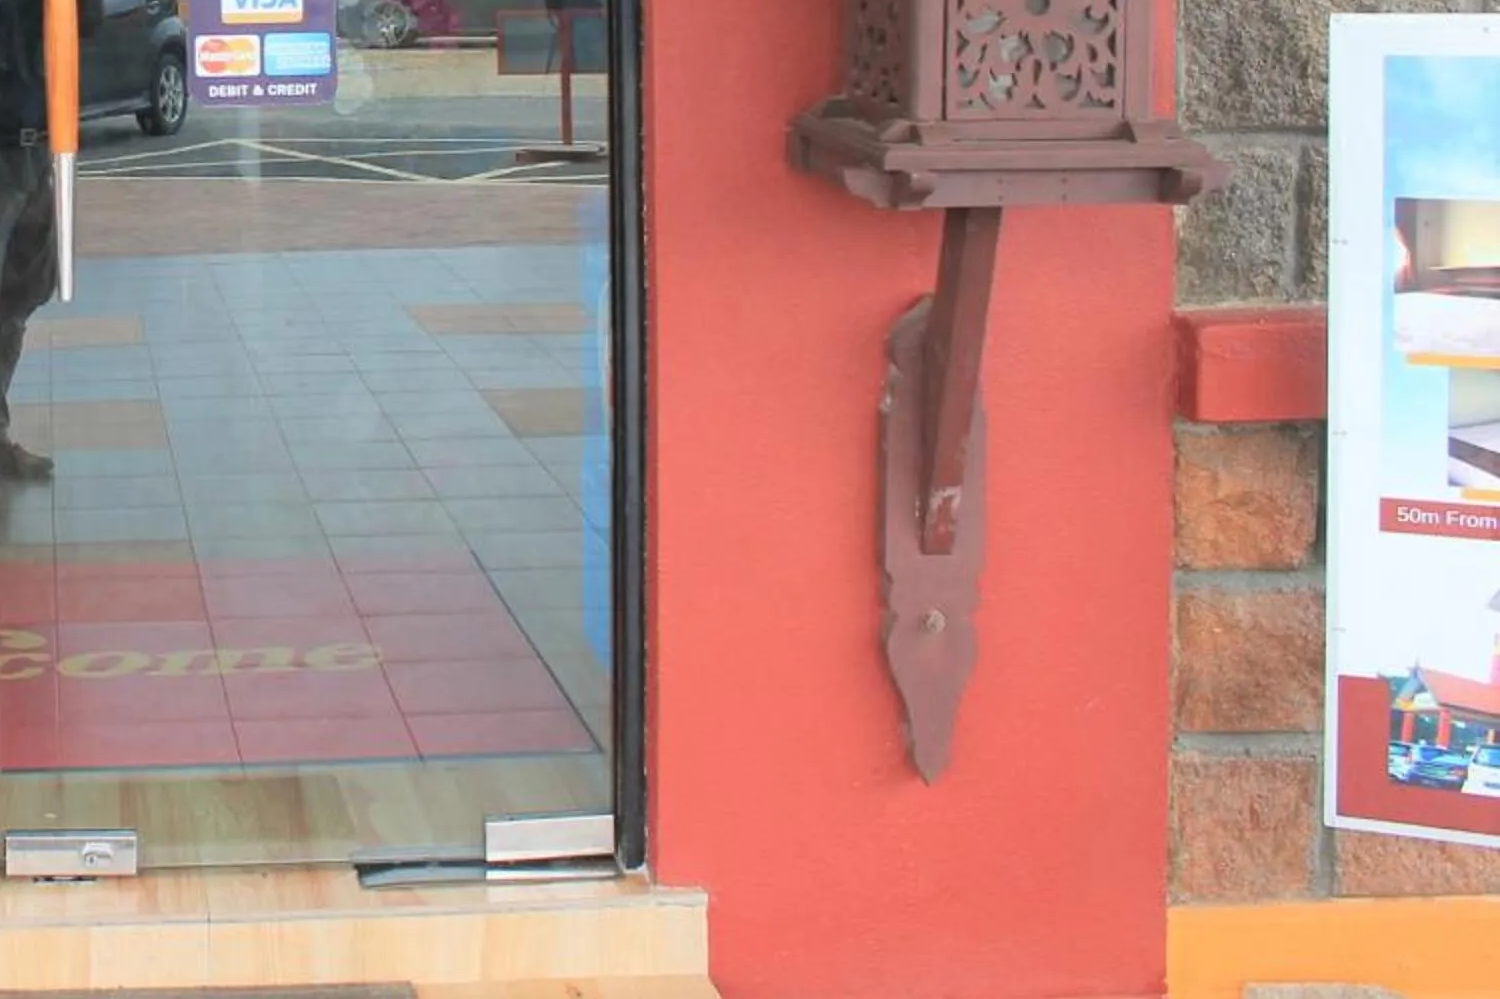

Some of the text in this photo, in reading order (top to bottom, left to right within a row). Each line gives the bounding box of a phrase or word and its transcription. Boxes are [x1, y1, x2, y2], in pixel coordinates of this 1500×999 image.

[208, 85, 248, 98] DEBIT
[268, 83, 317, 96] CREDIT
[1396, 506, 1497, 530] 50m From
